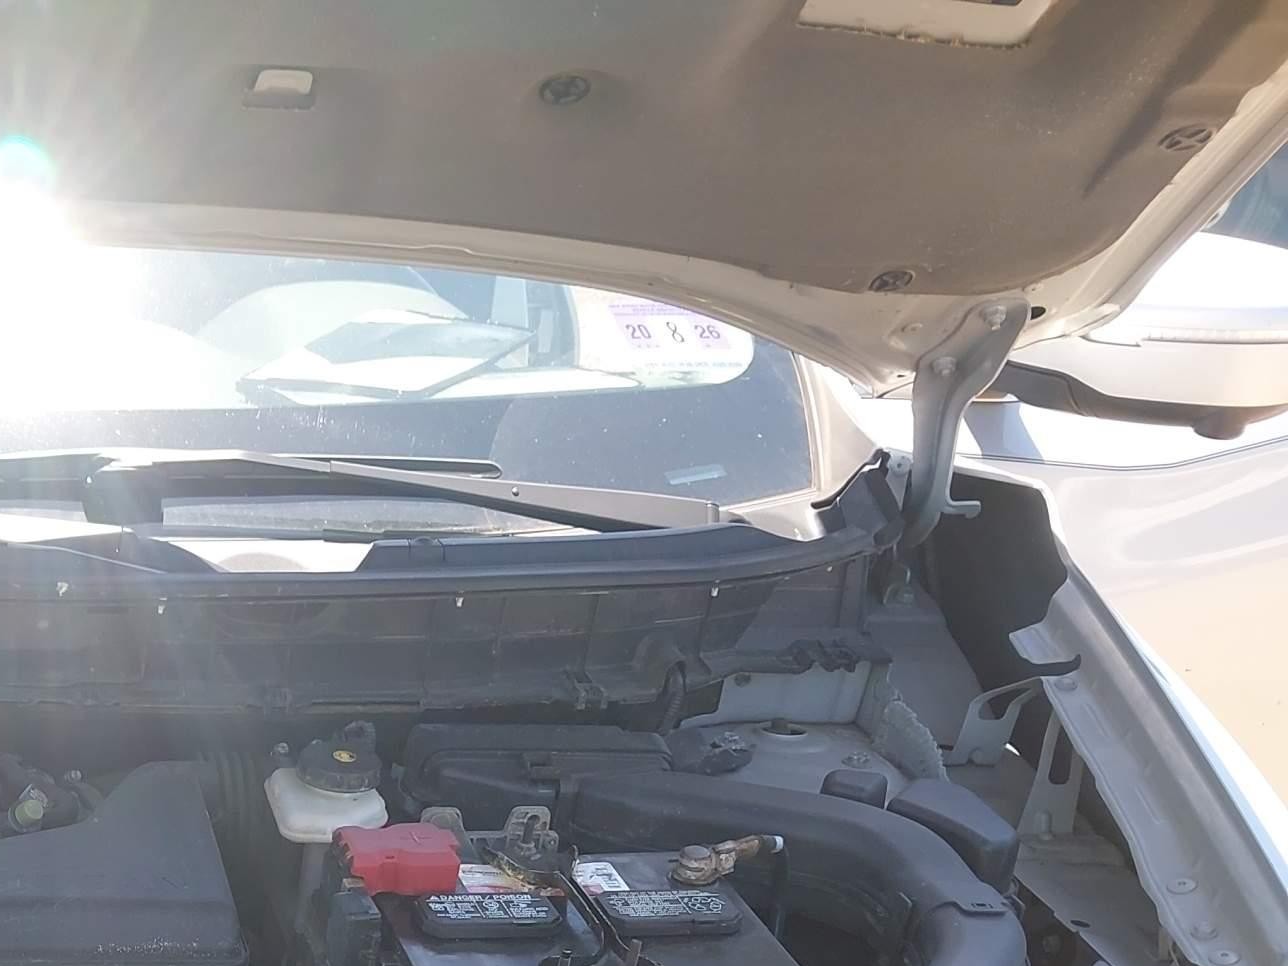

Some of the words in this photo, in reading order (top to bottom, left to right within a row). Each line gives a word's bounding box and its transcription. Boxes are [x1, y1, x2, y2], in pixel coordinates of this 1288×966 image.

[625, 324, 651, 339] 20
[666, 321, 685, 342] 8
[694, 324, 721, 339] 26
